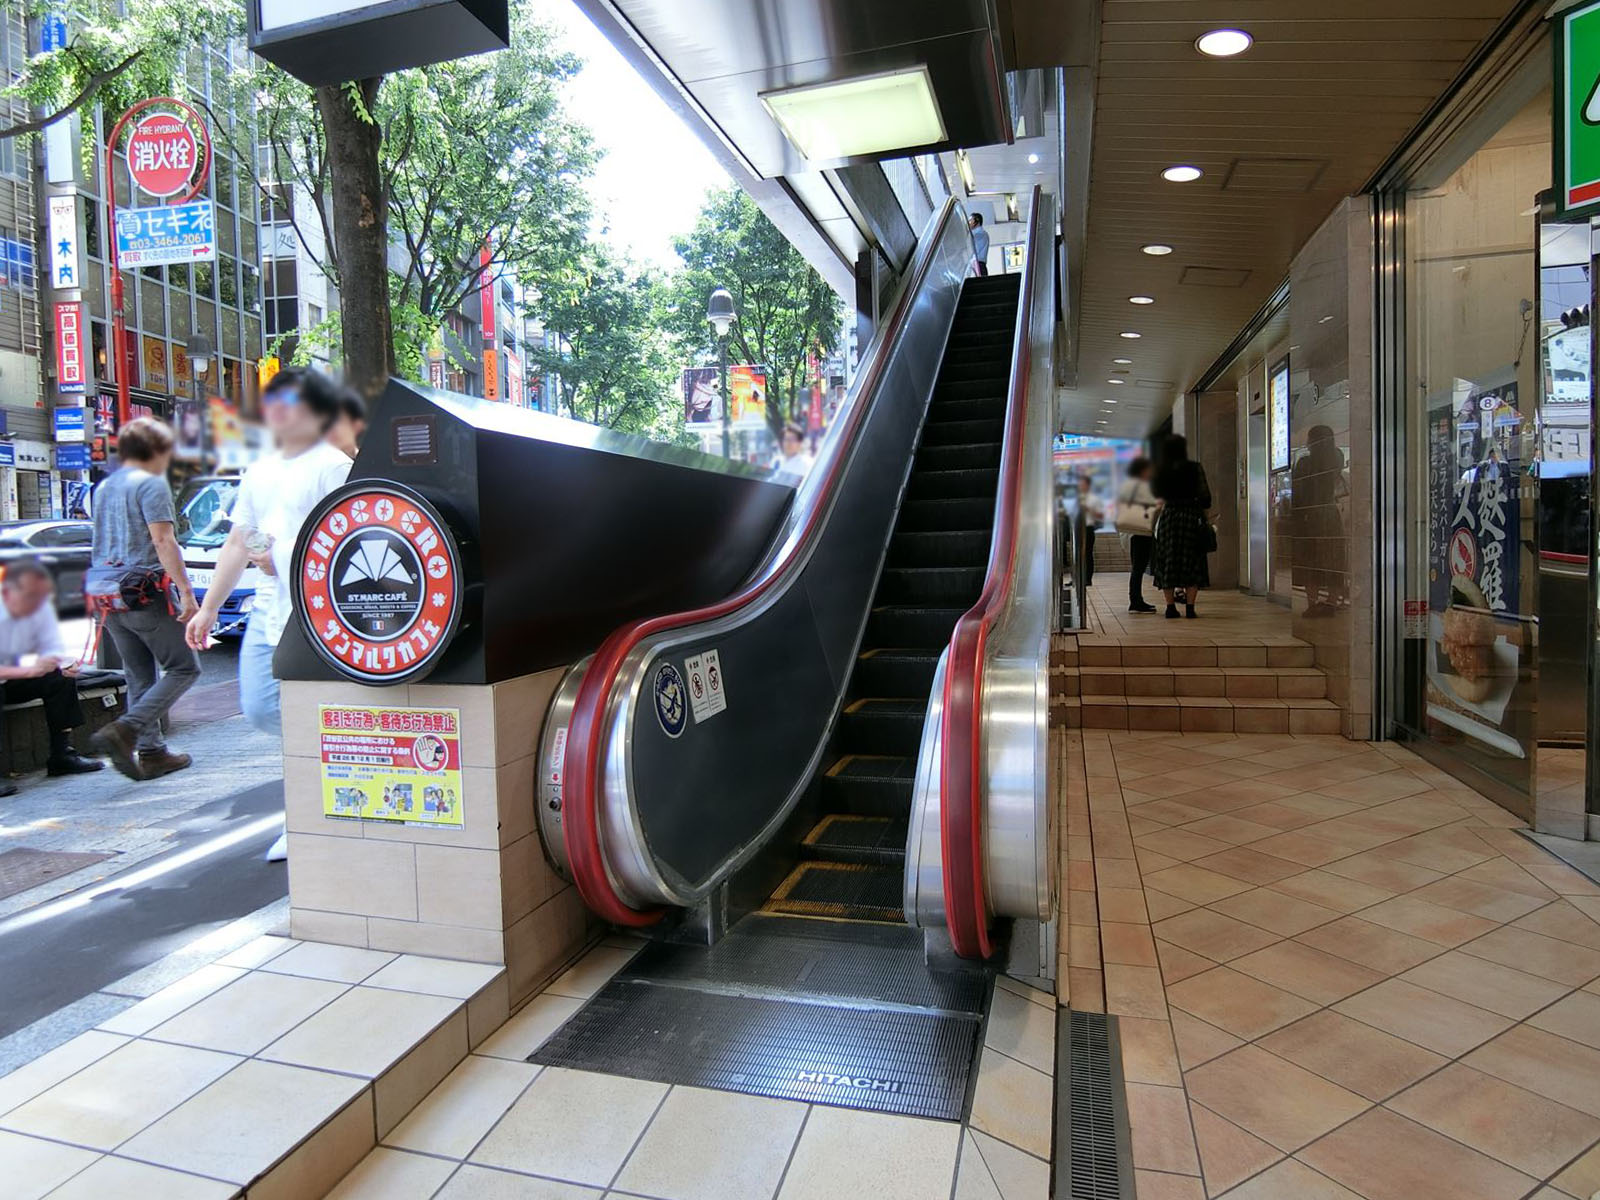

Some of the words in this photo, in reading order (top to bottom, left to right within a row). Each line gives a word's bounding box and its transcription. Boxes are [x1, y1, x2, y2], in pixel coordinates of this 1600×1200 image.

[138, 126, 153, 135] FIRE
[154, 124, 183, 134] HYDRANT
[134, 138, 191, 171] 消火栓
[58, 237, 72, 284] 木内
[323, 619, 440, 670] サンマルクカフェ
[798, 1070, 899, 1092] HITACHI
